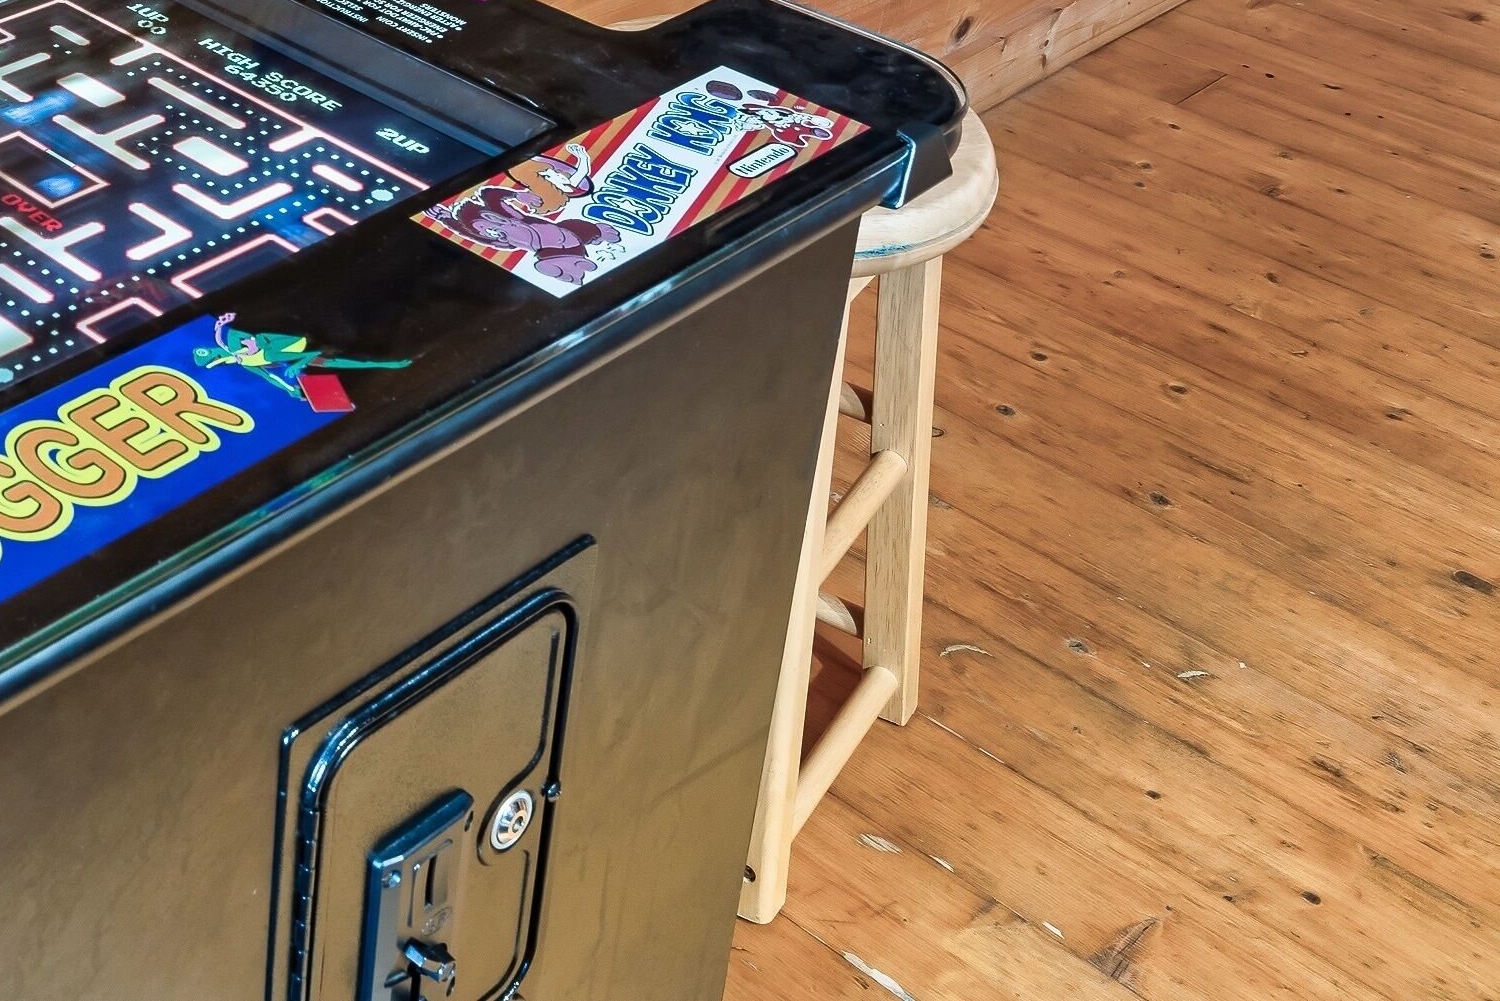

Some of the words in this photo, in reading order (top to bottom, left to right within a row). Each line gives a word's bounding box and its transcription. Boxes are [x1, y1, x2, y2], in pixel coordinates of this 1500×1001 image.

[126, 3, 169, 23] 1UP
[375, 16, 399, 27] COIN
[400, 11, 448, 33] ENERGIZER
[420, 3, 468, 26] MONSTERS
[429, 14, 459, 28] AFTER
[137, 19, 167, 35] 00
[395, 26, 428, 41] INSERT
[198, 38, 260, 70] HIGH
[265, 71, 343, 112] SCORE
[224, 64, 298, 102] 64350
[376, 127, 431, 155] 2UP
[582, 143, 698, 236] DONKEY
[646, 91, 740, 156] KONG
[735, 147, 790, 175] Nintendo
[1, 192, 63, 232] OVER
